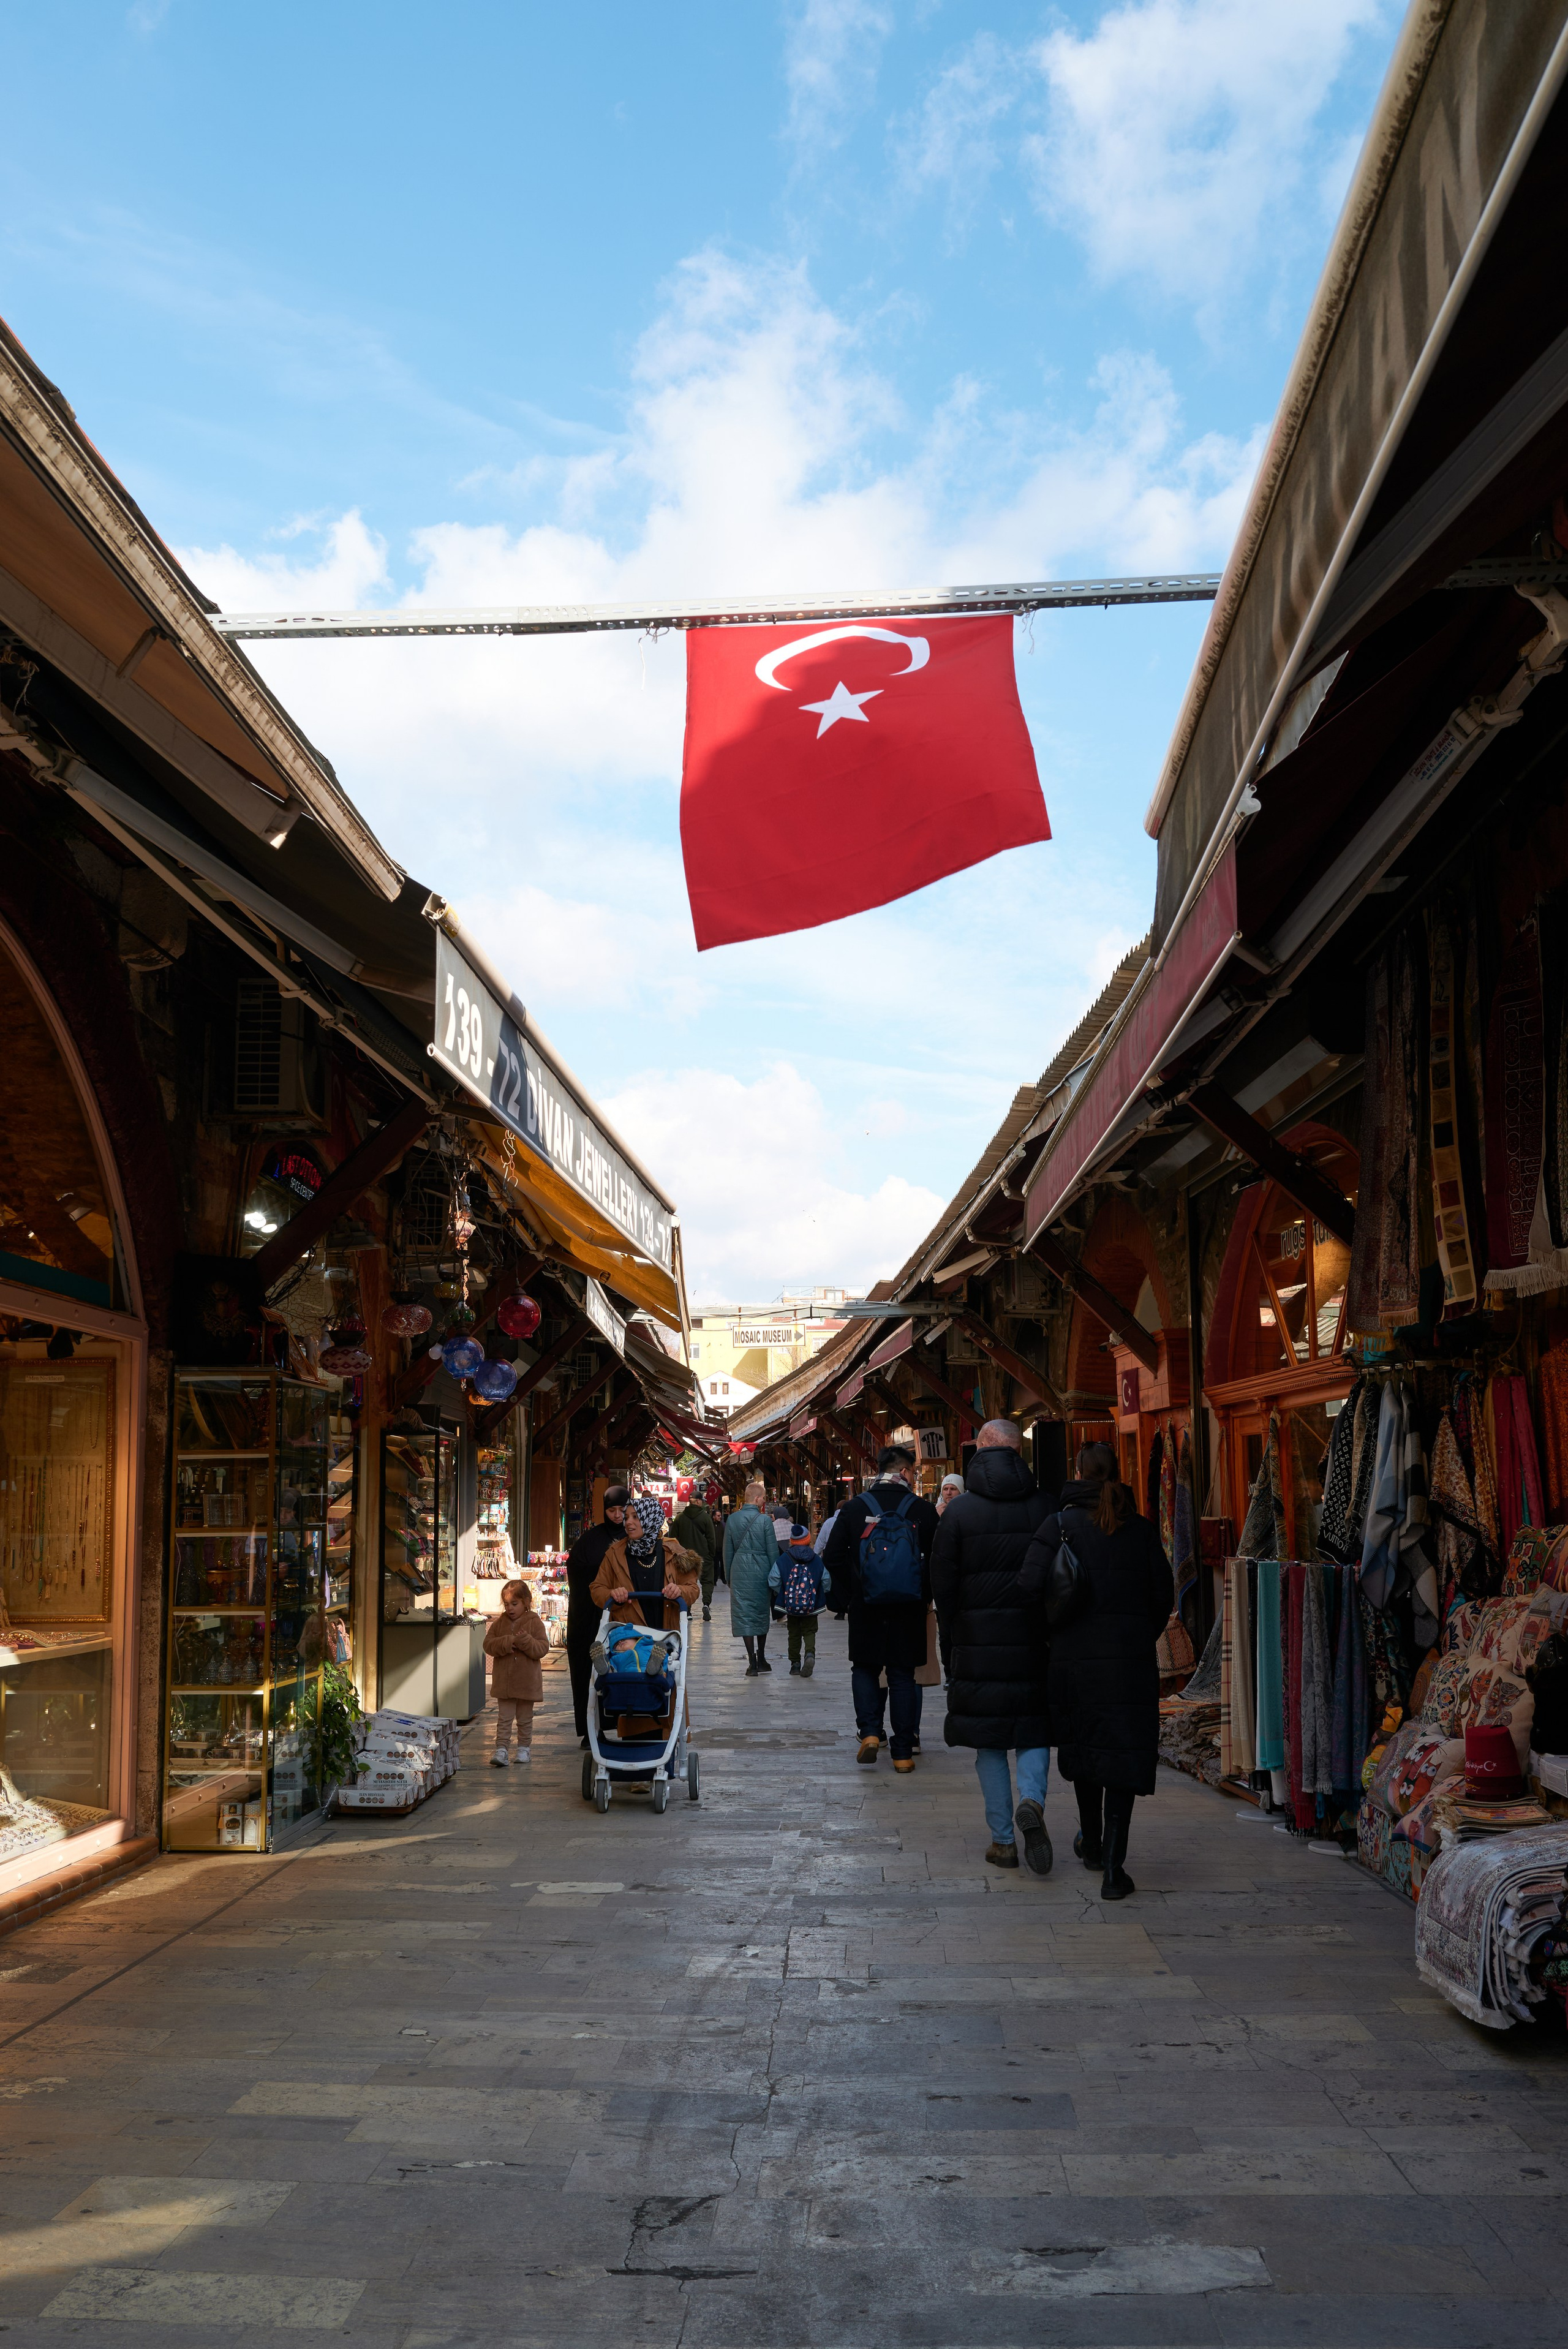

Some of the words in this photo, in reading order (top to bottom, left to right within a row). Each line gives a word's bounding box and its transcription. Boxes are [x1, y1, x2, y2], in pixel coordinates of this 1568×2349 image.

[445, 973, 483, 1078] 139
[499, 1036, 521, 1120] 72
[576, 1131, 638, 1237] JEWELLERY
[640, 1201, 654, 1253] 139
[657, 1221, 671, 1267] 72
[1281, 1221, 1305, 1261] rugs
[735, 1330, 761, 1344] MOSAIC
[763, 1330, 792, 1343] MUSEUM
